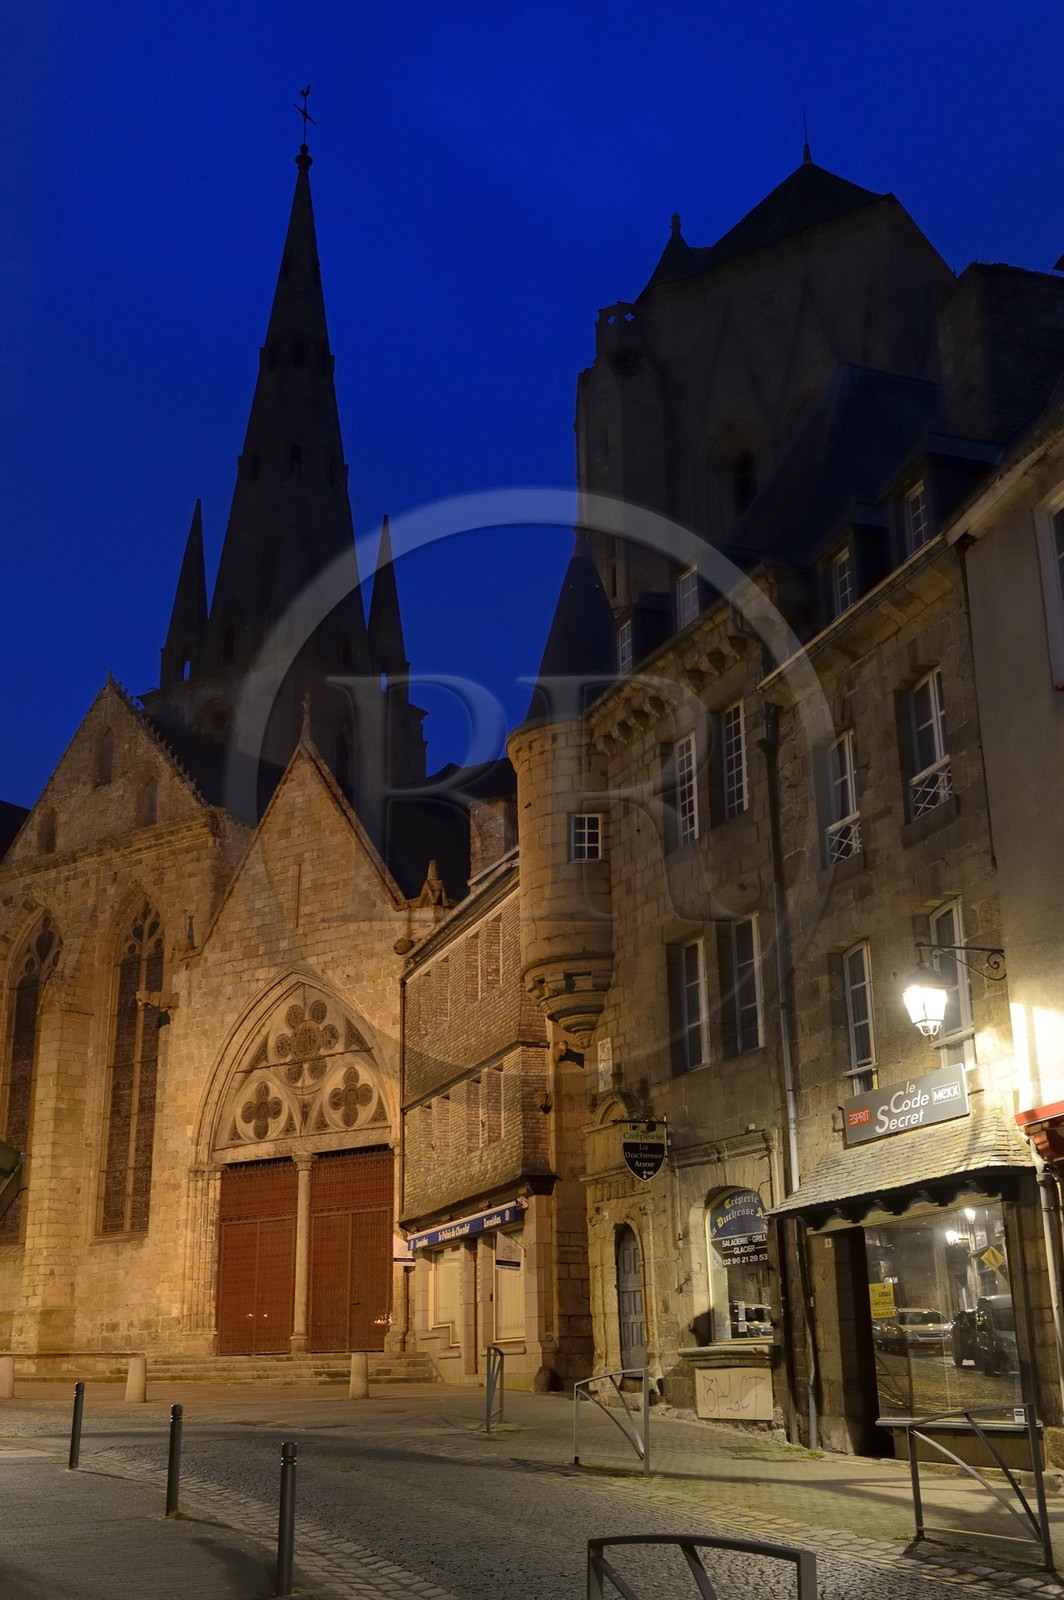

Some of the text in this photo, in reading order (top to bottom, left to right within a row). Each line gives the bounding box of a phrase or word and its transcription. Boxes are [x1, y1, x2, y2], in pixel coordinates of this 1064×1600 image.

[905, 1081, 916, 1095] le
[889, 1090, 930, 1114] Code
[849, 1109, 871, 1126] ESPRIT
[874, 1105, 925, 1134] Secret
[716, 1208, 755, 1229] Duchesse
[721, 1236, 749, 1248] SALADERIE
[751, 1233, 767, 1243] GRILL
[733, 1245, 756, 1254] GLACIER
[759, 1253, 768, 1261] 53
